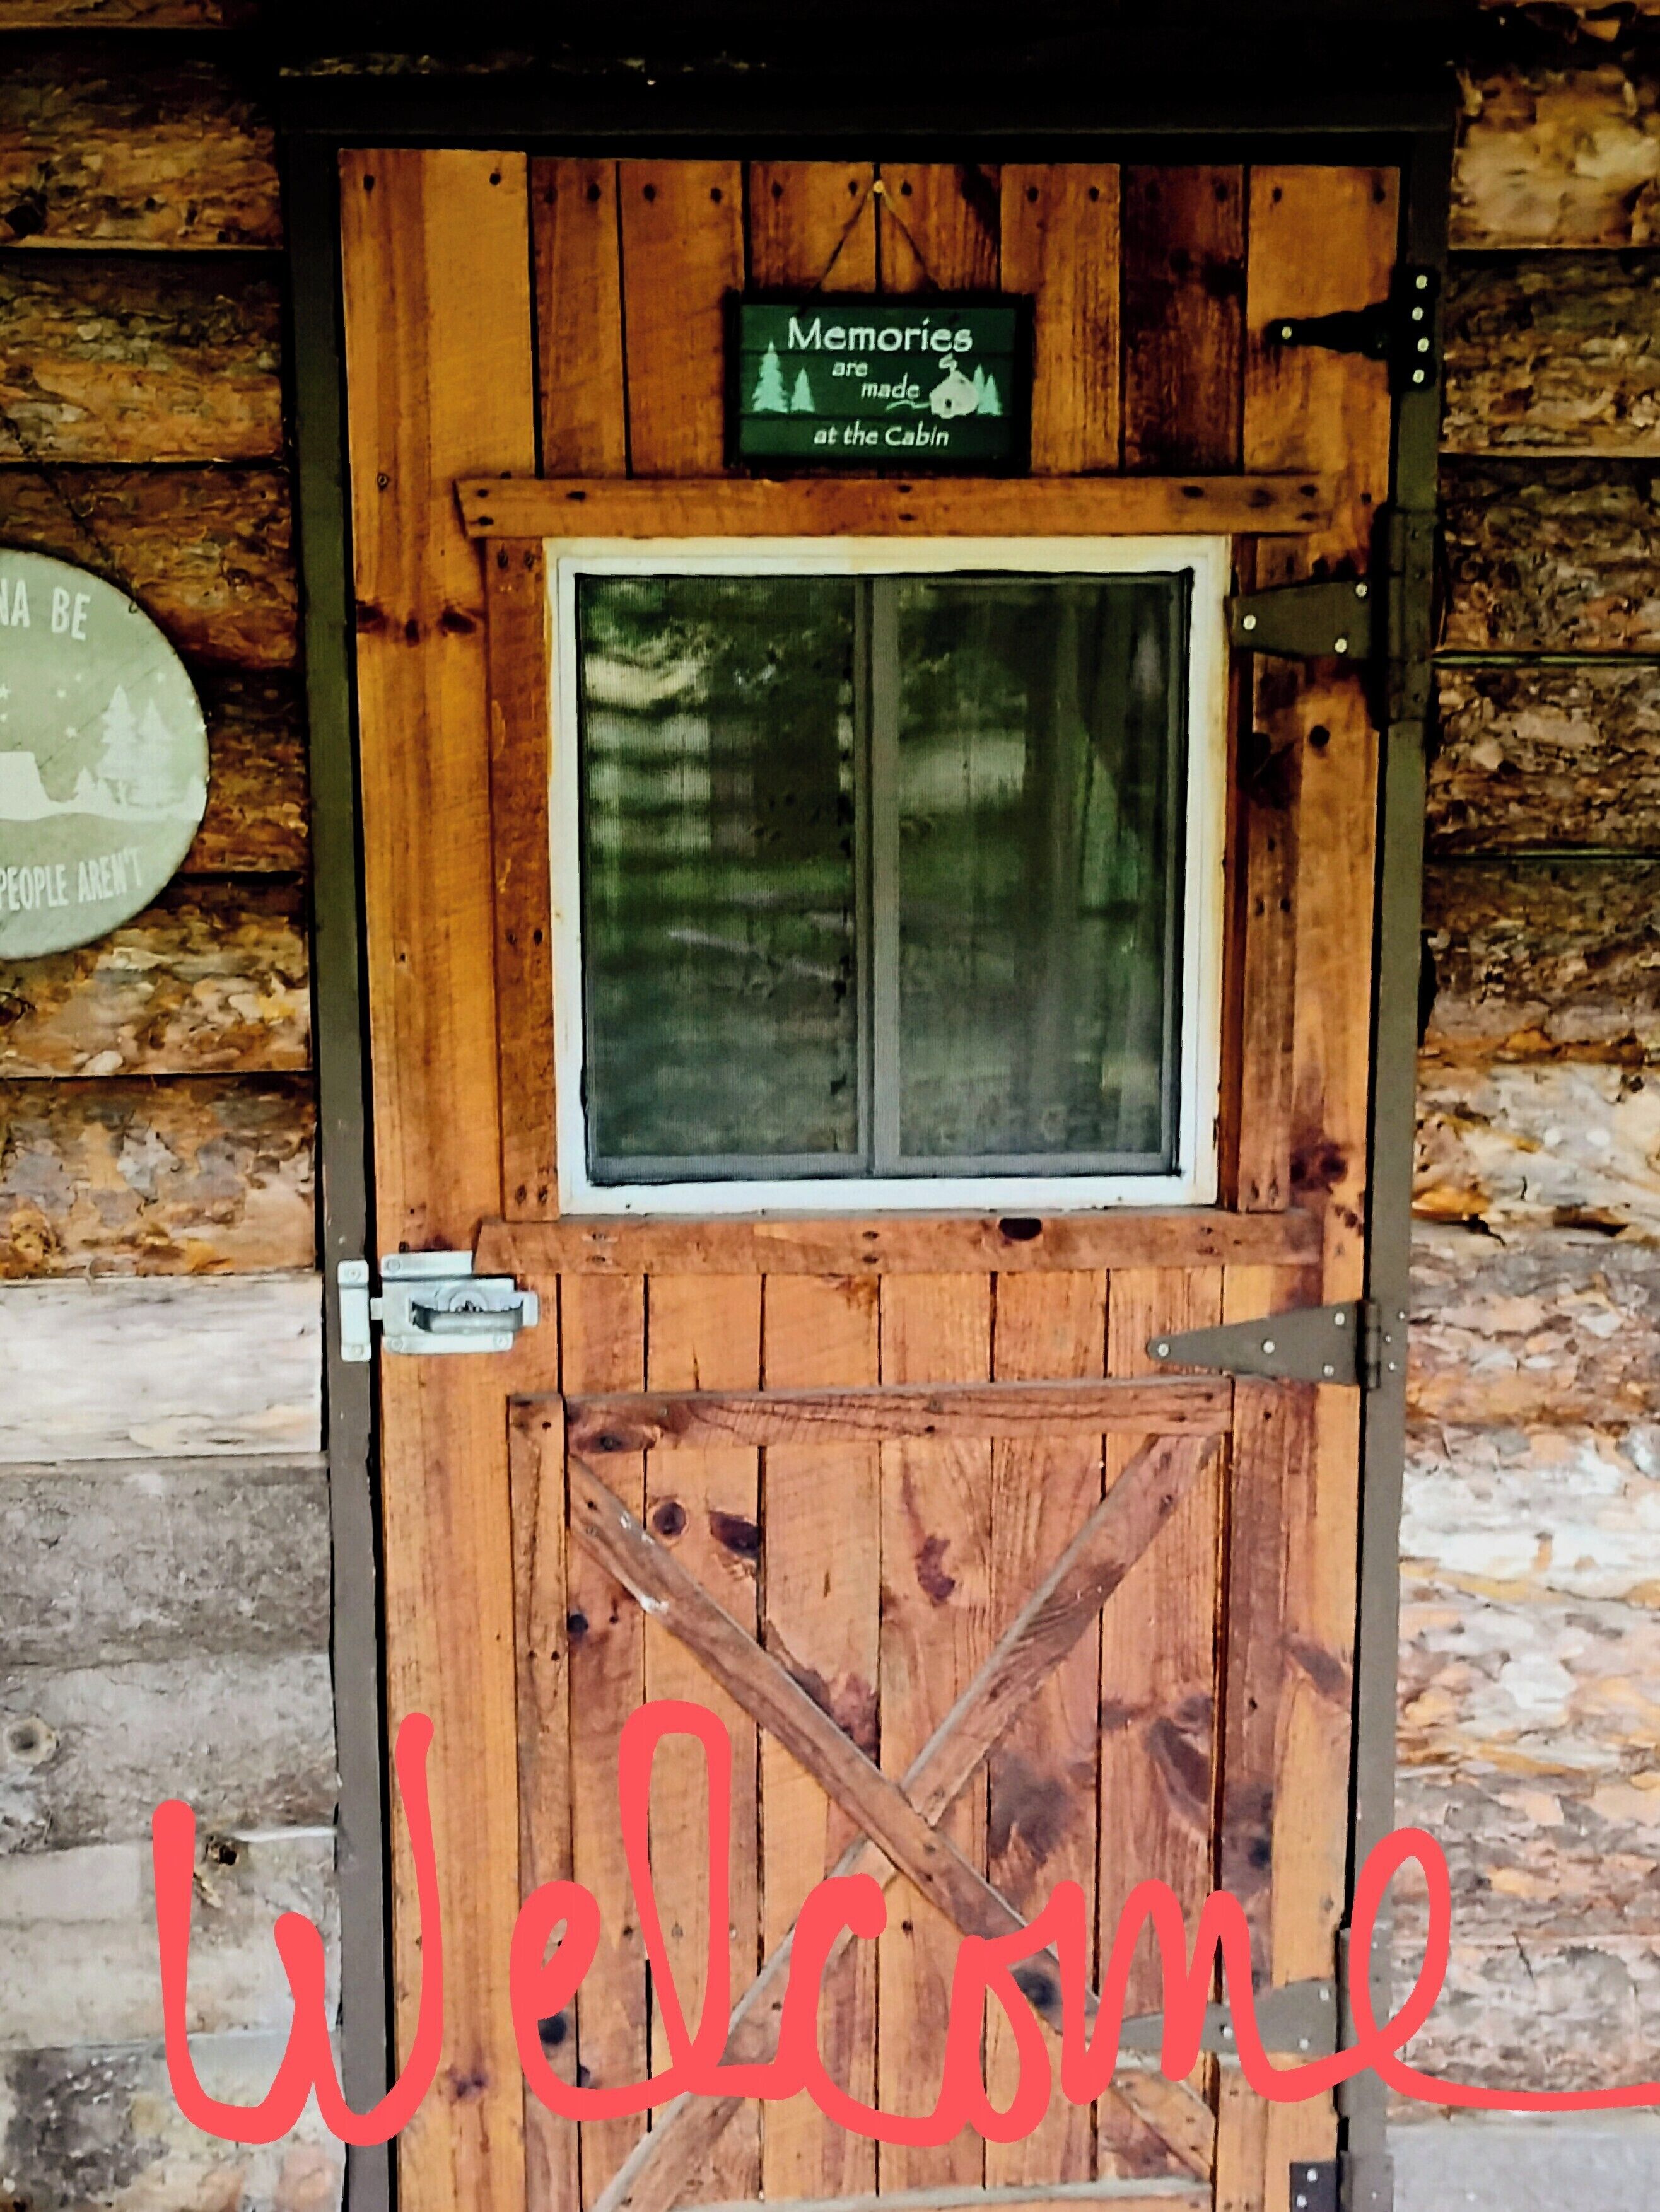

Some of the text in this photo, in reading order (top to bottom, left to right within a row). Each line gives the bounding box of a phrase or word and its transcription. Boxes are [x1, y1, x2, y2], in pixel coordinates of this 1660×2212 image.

[788, 317, 973, 353] Memories
[832, 361, 868, 377] are
[861, 373, 920, 399] made
[814, 420, 950, 446] at the Cabin
[51, 586, 91, 641] BE
[78, 847, 143, 903] AREN'T
